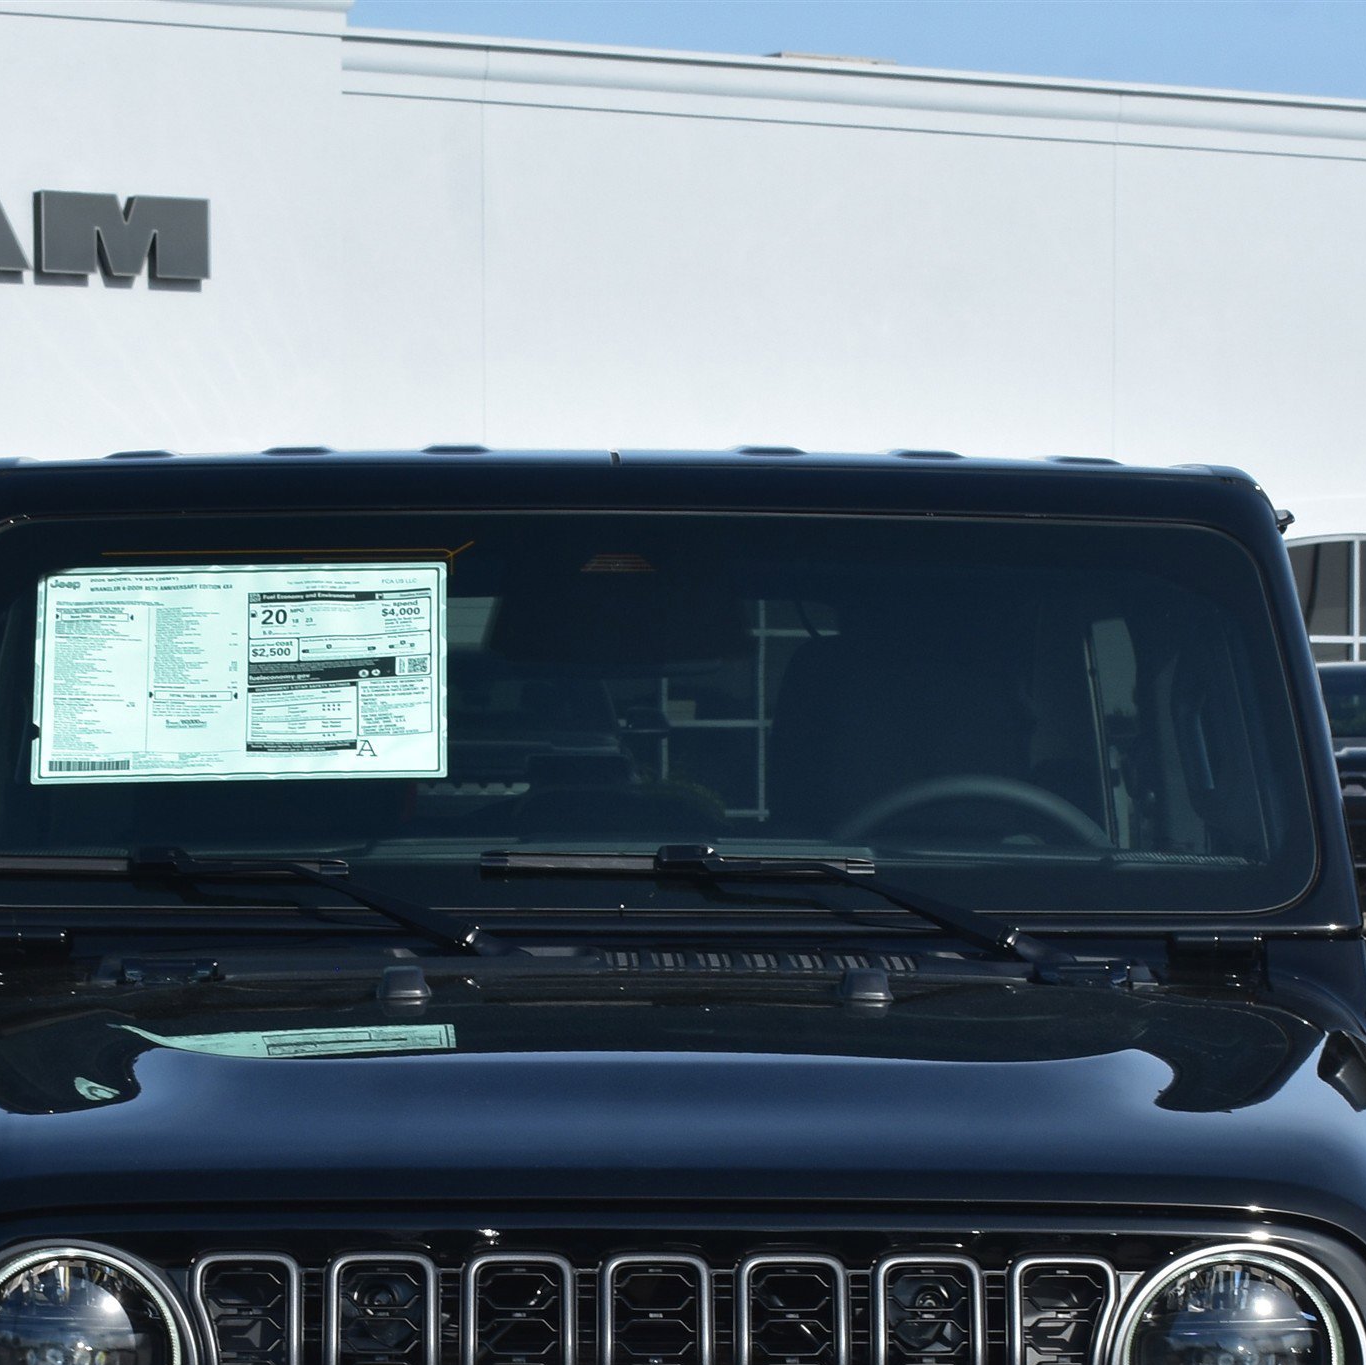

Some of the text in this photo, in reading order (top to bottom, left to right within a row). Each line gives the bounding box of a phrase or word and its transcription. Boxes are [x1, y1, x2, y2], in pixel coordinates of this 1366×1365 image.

[50, 579, 81, 591] Jeep
[261, 609, 288, 625] 20
[381, 607, 421, 617] $4,000
[251, 647, 291, 658] $2,500
[249, 673, 311, 681] fueleconomy.gov
[356, 740, 378, 757] A
